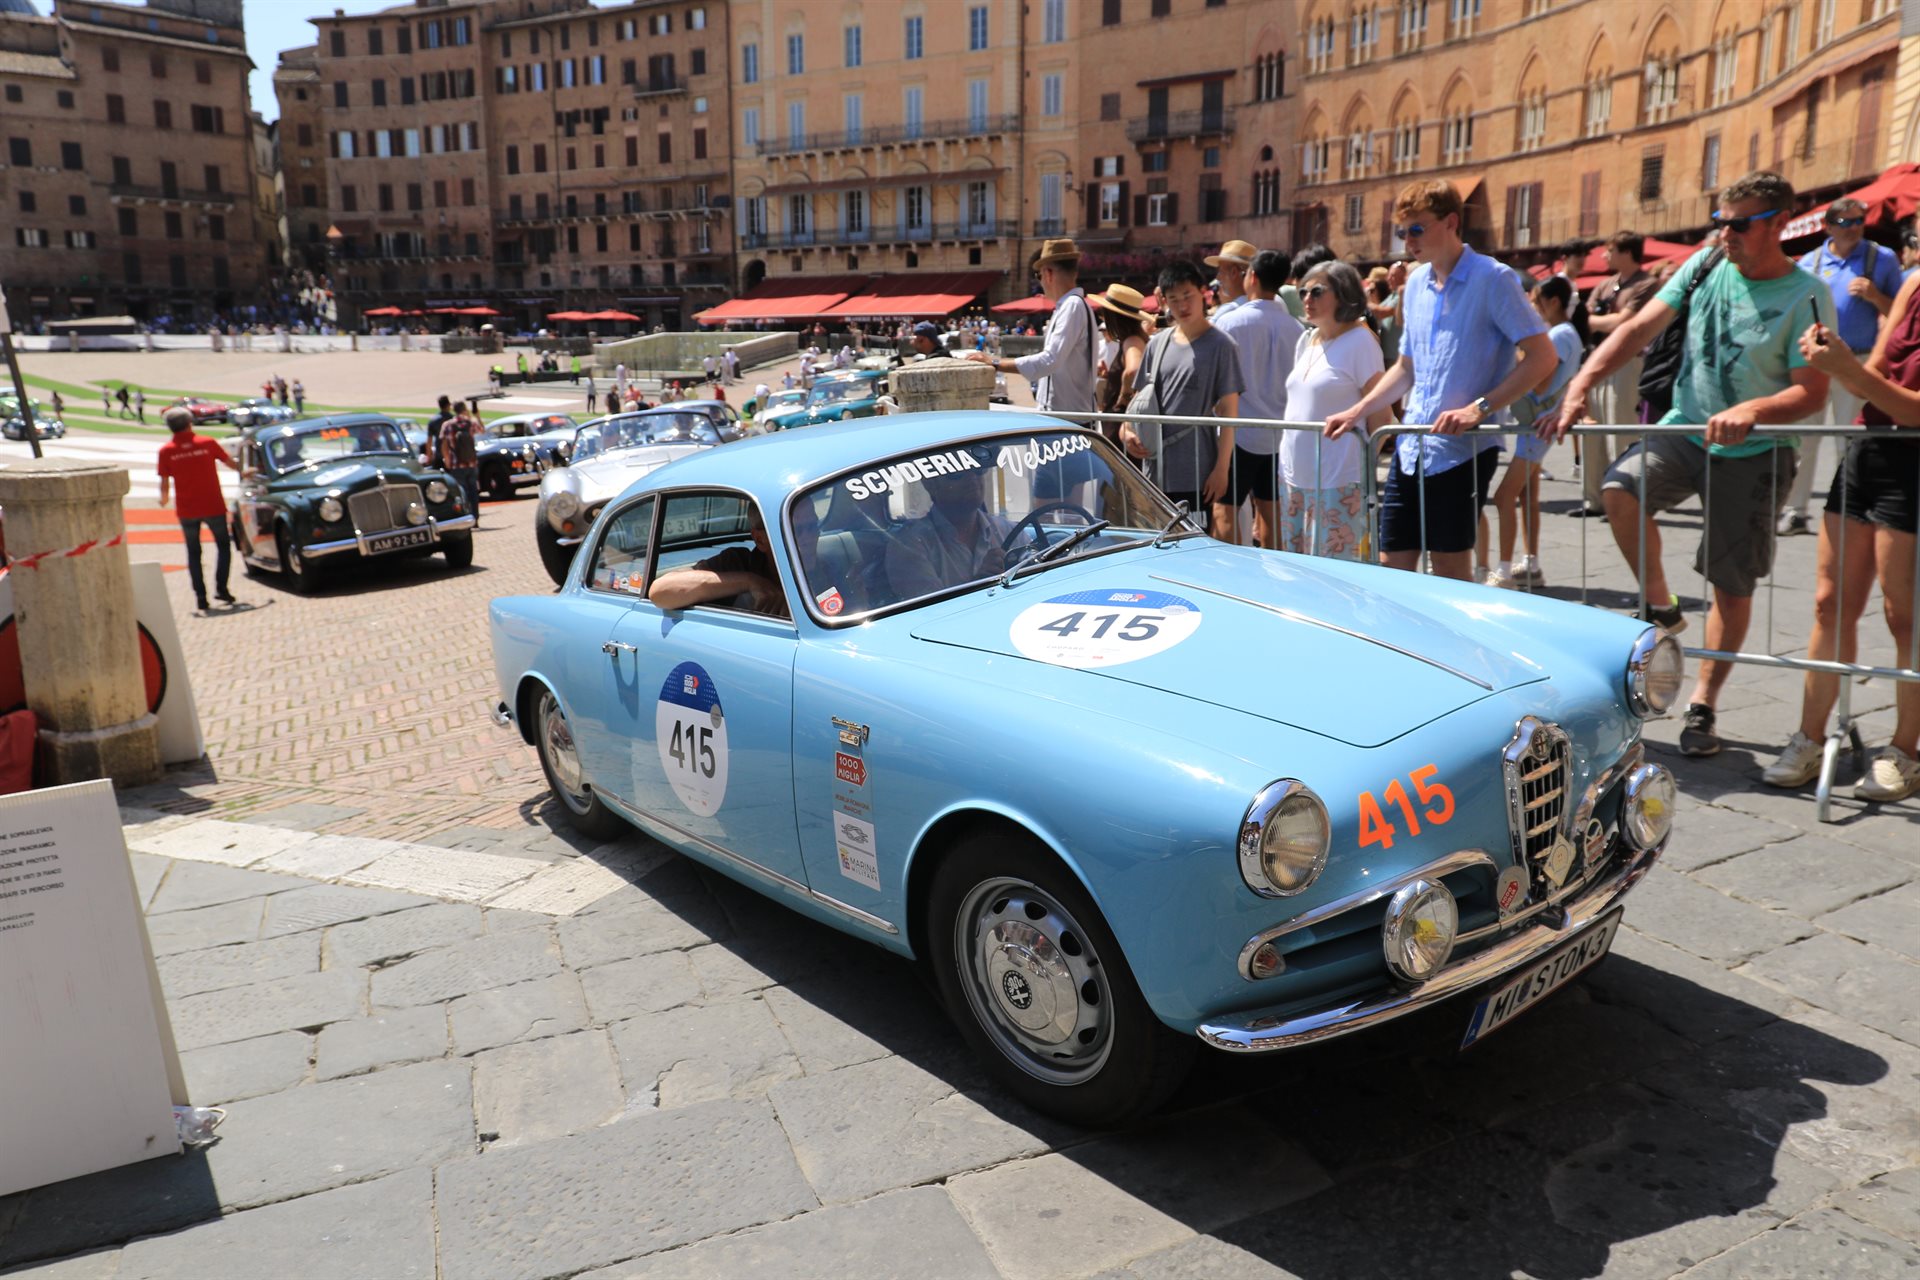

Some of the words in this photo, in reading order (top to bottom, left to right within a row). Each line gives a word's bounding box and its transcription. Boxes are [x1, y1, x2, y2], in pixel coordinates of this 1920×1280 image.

[845, 450, 981, 500] SCUDERIA
[996, 434, 1092, 477] Velsecco
[1037, 612, 1167, 641] 415
[669, 719, 716, 779] 415
[839, 756, 859, 770] 1000
[837, 768, 860, 783] MIGLIA
[1358, 763, 1455, 849] 415
[26, 854, 59, 865] PROTETTA
[849, 857, 877, 874] MARINA
[29, 882, 65, 893] PERCORSO
[1488, 984, 1520, 1028] MI
[1532, 935, 1593, 998] STON
[1589, 926, 1608, 958] 3
